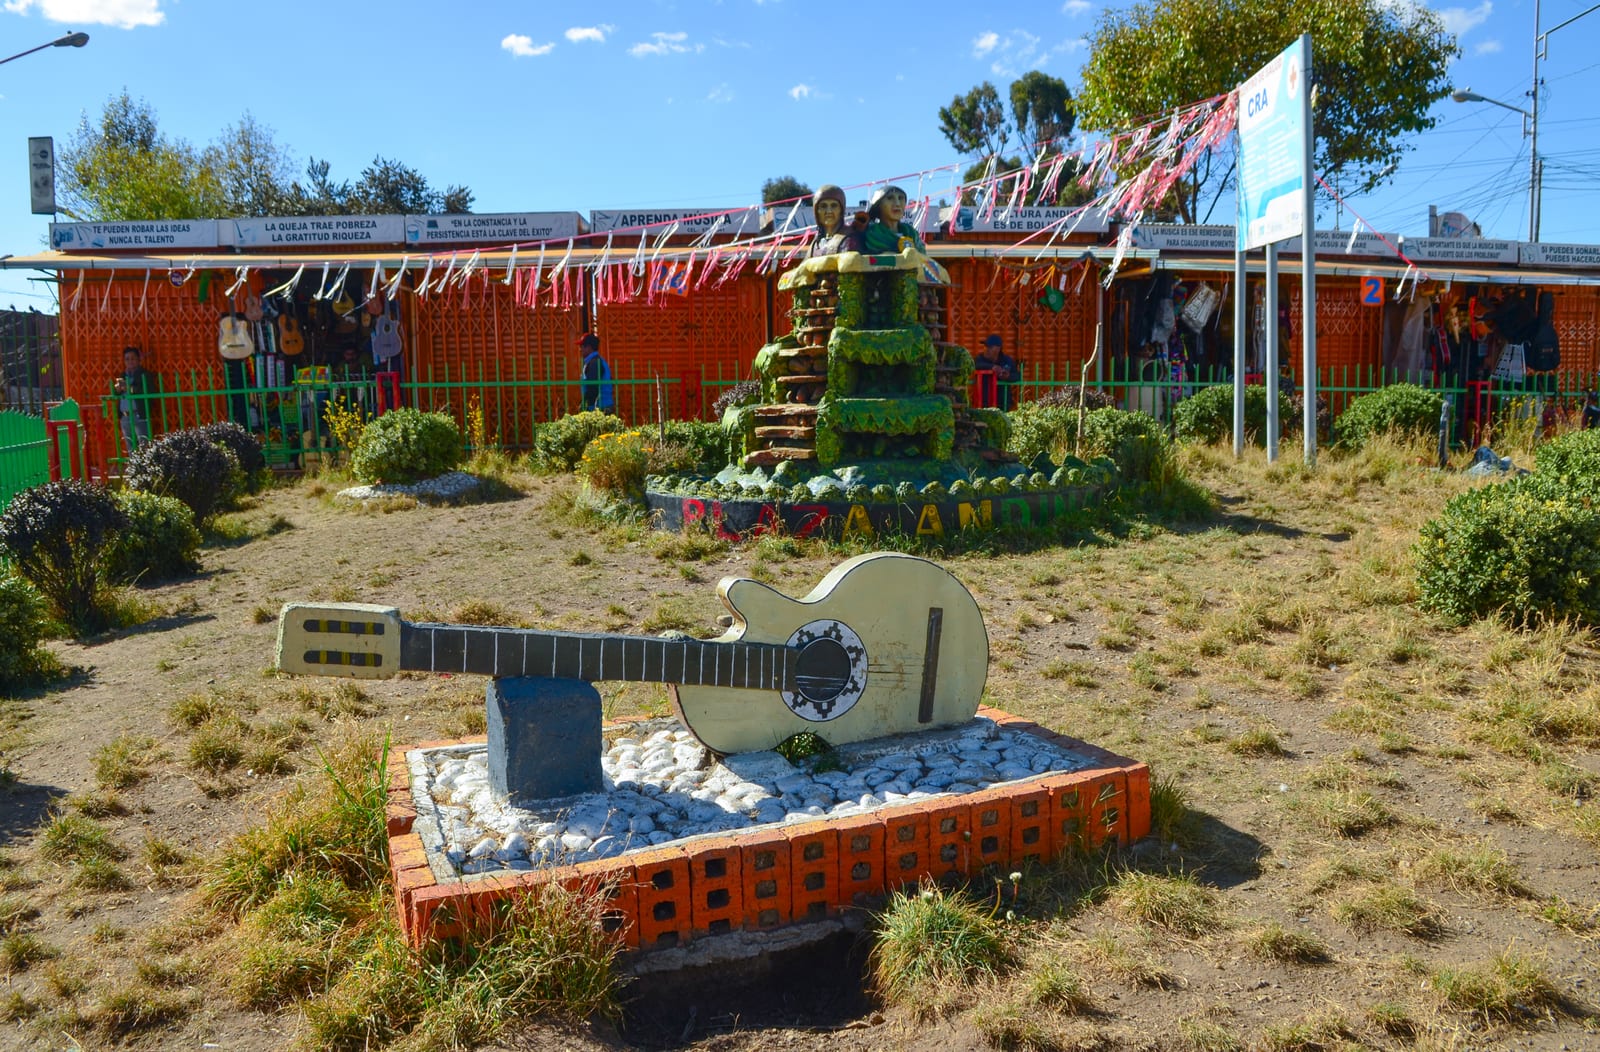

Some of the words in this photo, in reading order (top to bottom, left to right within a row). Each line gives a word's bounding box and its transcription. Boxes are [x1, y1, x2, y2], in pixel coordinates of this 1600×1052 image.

[1248, 88, 1269, 118] CRA
[993, 209, 1042, 218] CLTURA
[464, 219, 472, 227] LA
[473, 218, 511, 227] CONSTANCIA
[512, 218, 518, 226] Y
[519, 218, 527, 226] LA
[620, 213, 679, 227] APRENDA
[93, 226, 101, 234] TE
[103, 225, 130, 234] PUEDEN
[132, 225, 154, 233] ROBAR
[156, 224, 169, 233] LAS
[171, 224, 191, 233] IDEAS
[265, 223, 277, 231] LA
[279, 222, 308, 231] QUEJA
[310, 221, 334, 230] TRAE
[336, 220, 377, 230] POBREZA
[993, 221, 1007, 230] ES
[1012, 221, 1025, 230] DE
[1027, 221, 1069, 230] BOLIVA
[272, 233, 284, 242] LA
[286, 232, 330, 241] GRATITUD
[332, 231, 371, 241] RIQUEZA
[426, 230, 470, 240] PERSISTENCIA
[489, 229, 497, 237] LA
[499, 228, 518, 237] CLAVE
[519, 228, 530, 237] DEL
[1223, 229, 1233, 237] QUE
[108, 235, 132, 244] NUNCA
[134, 235, 142, 244] EL
[144, 235, 175, 244] TALENTO
[1181, 239, 1209, 247] CUALQUIER
[1210, 240, 1235, 248] MOMENTO
[1541, 246, 1548, 254] SI
[1549, 246, 1574, 254] PUEDES
[1545, 254, 1570, 262] PUEDES
[1571, 255, 1600, 263] HACERLO
[1365, 279, 1381, 303] 2
[682, 498, 874, 544] PLAZA
